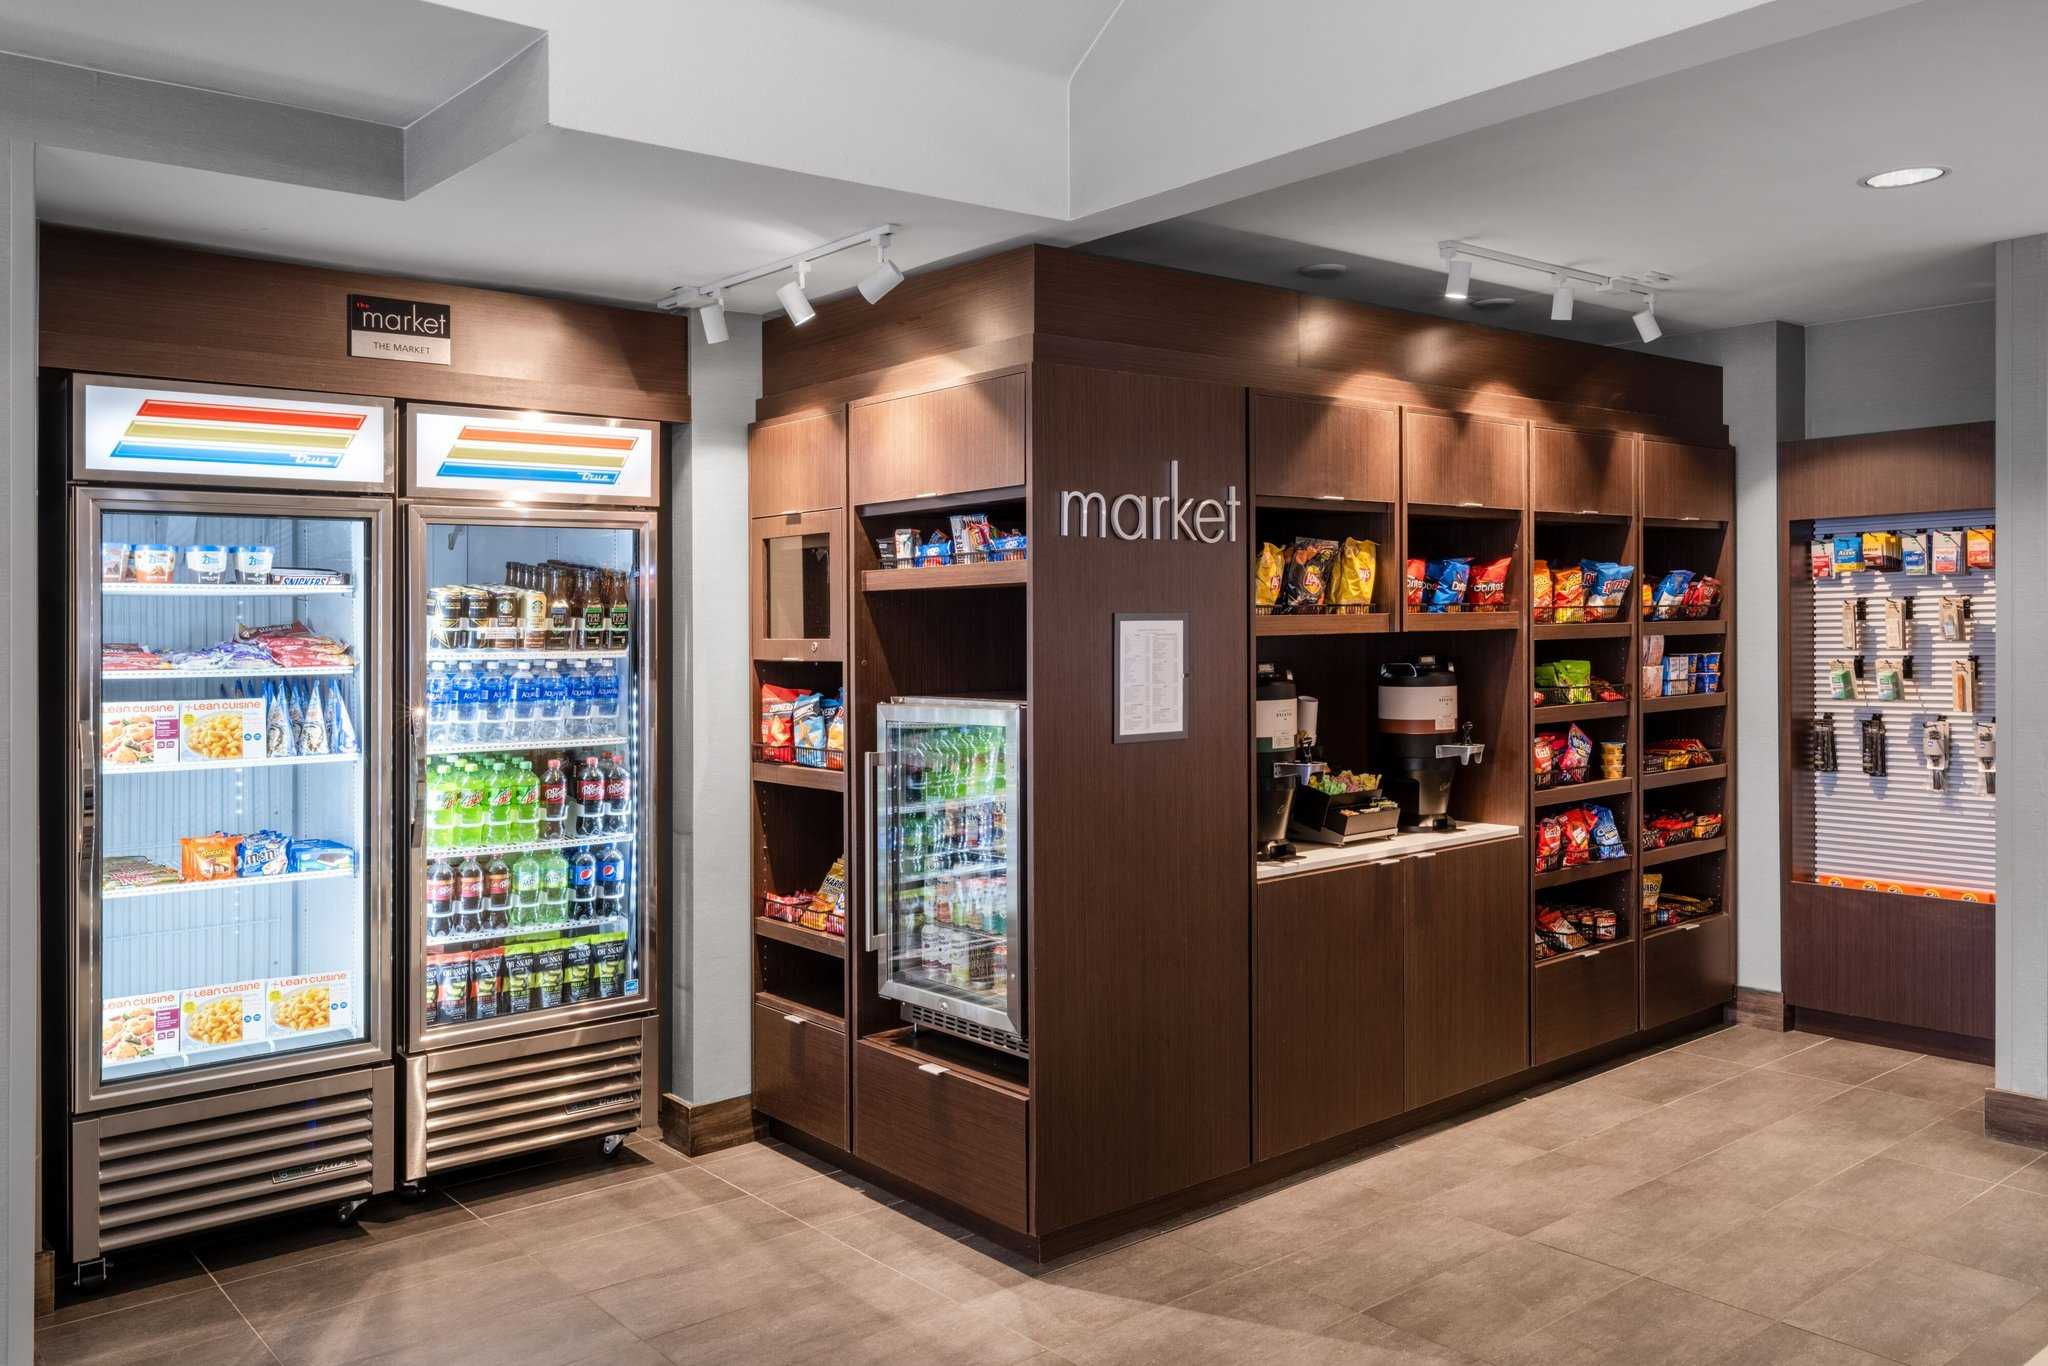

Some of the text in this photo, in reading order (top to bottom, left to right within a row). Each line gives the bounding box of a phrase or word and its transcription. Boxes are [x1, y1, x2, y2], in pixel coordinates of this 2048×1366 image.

[363, 304, 446, 335] market
[373, 341, 431, 354] THE MARKET
[1060, 459, 1241, 544] market
[283, 576, 328, 586] SNICKERS
[1473, 582, 1504, 592] Doritos
[132, 703, 175, 713] cuisine
[193, 700, 262, 711] Lean cuisine
[281, 971, 348, 988] Lean cuisine
[194, 981, 261, 998] Lean cuisine
[133, 993, 175, 1006] cuisine
